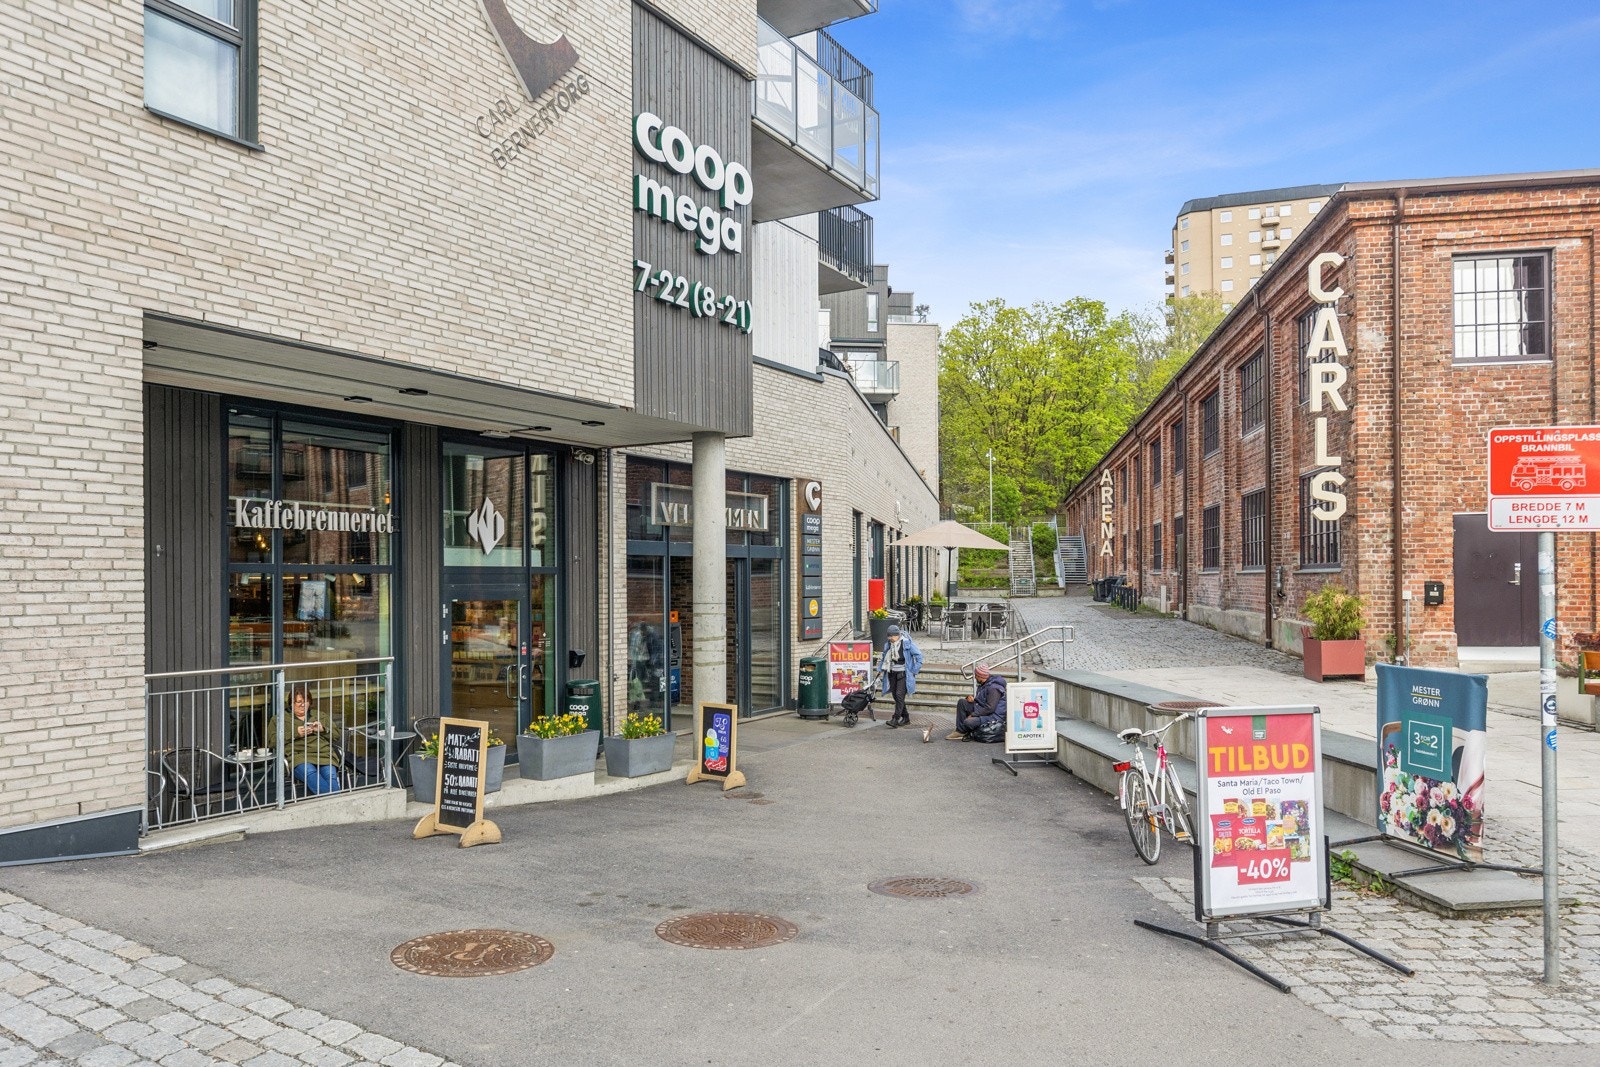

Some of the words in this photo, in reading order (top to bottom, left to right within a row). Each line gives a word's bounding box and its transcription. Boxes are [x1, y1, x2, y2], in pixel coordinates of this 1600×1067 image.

[476, 95, 520, 138] CARL
[633, 112, 754, 211] coop
[633, 174, 742, 255] mega
[1307, 252, 1349, 521] CARLS
[1521, 444, 1575, 452] BRANNBIL
[1099, 468, 1114, 557] ARENA
[1511, 503, 1561, 511] BREDDE
[1565, 503, 1572, 511] 7
[1576, 503, 1585, 511] M
[234, 497, 394, 534] Kaffebrenneriet
[1509, 515, 1558, 523] LENGDE
[1562, 515, 1575, 523] 12
[832, 652, 869, 660] TILBUD
[1412, 686, 1440, 696] MESTER
[1413, 697, 1440, 707] GRØNN
[448, 734, 464, 747] MAT
[1413, 732, 1420, 745] 3
[1430, 735, 1438, 749] 2
[455, 748, 479, 763] RABATT
[1208, 743, 1310, 772] TILBUD
[459, 776, 478, 788] RABATT
[1217, 780, 1238, 788] Santa
[1242, 787, 1255, 796] Old
[1264, 786, 1282, 794] Paso
[1240, 857, 1289, 879] -40%
